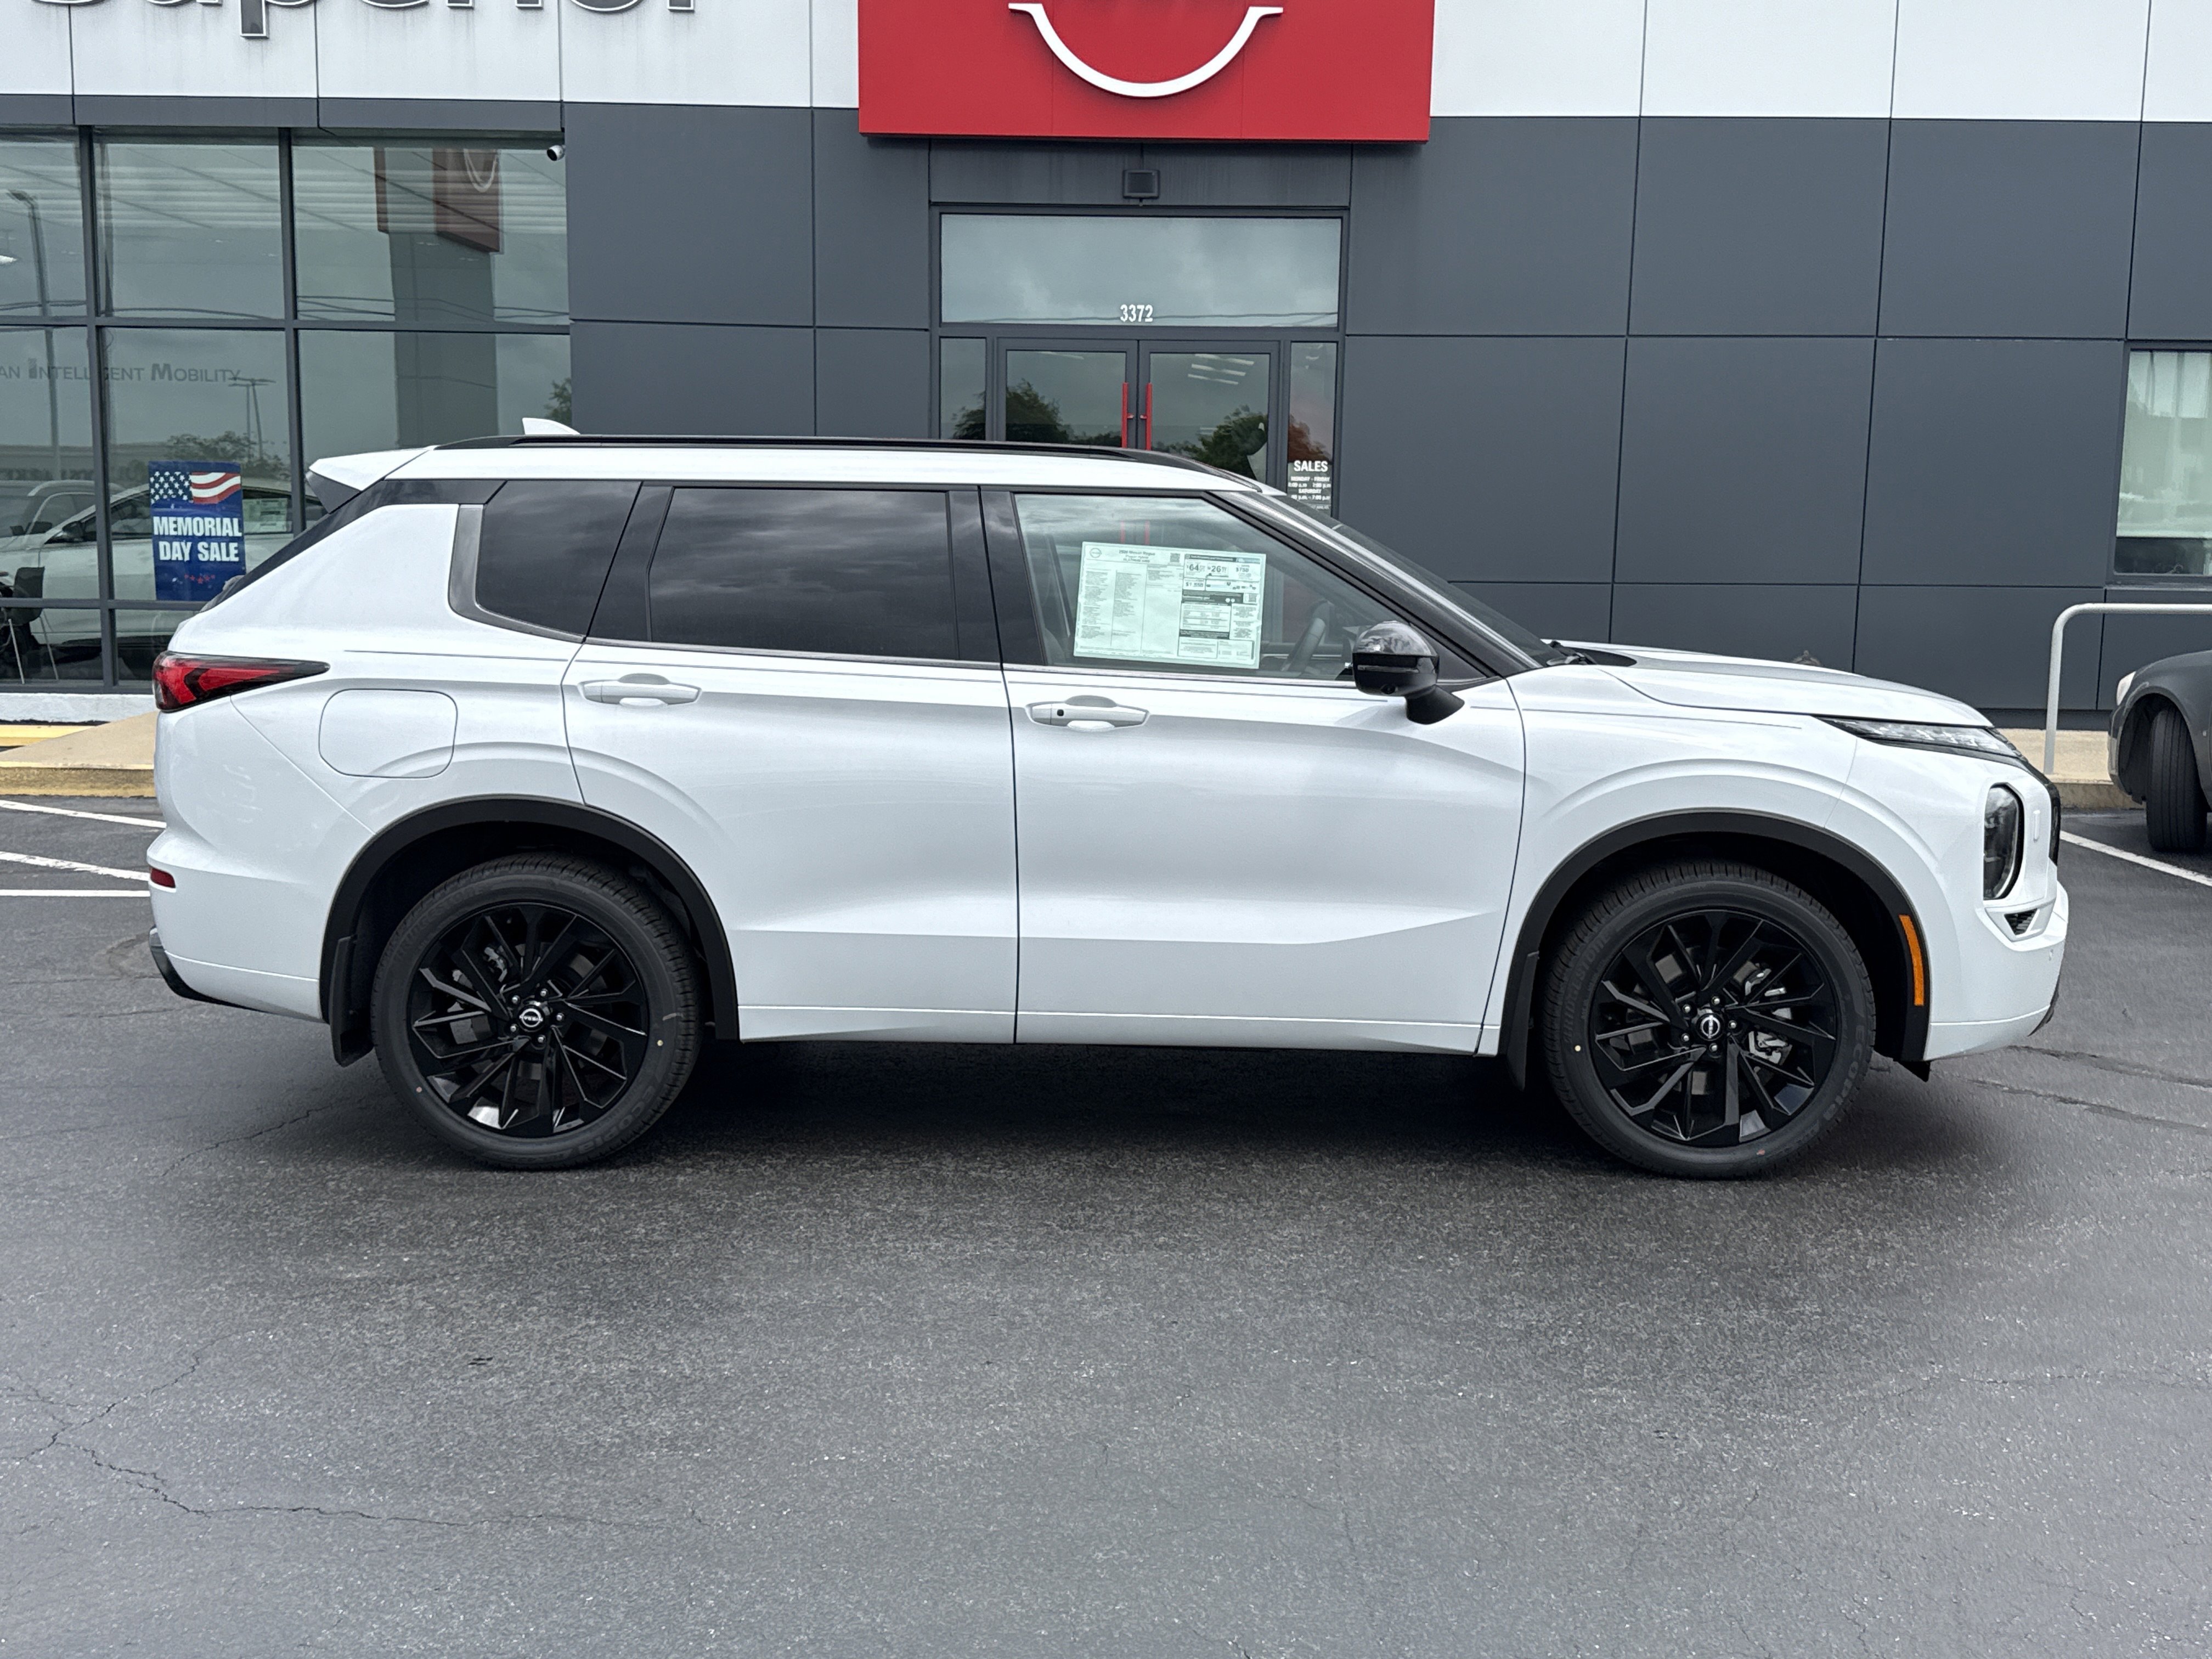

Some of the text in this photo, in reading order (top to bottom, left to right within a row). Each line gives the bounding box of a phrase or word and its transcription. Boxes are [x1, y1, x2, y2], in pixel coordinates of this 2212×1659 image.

[1120, 304, 1153, 323] 3372
[29, 358, 145, 381] INTELLENT
[151, 363, 241, 383] MOBILITY
[1294, 460, 1328, 472] SALES
[153, 516, 242, 537] MEMORIAL
[159, 540, 239, 562] DAY SALE
[579, 1085, 656, 1154] ECOPIA
